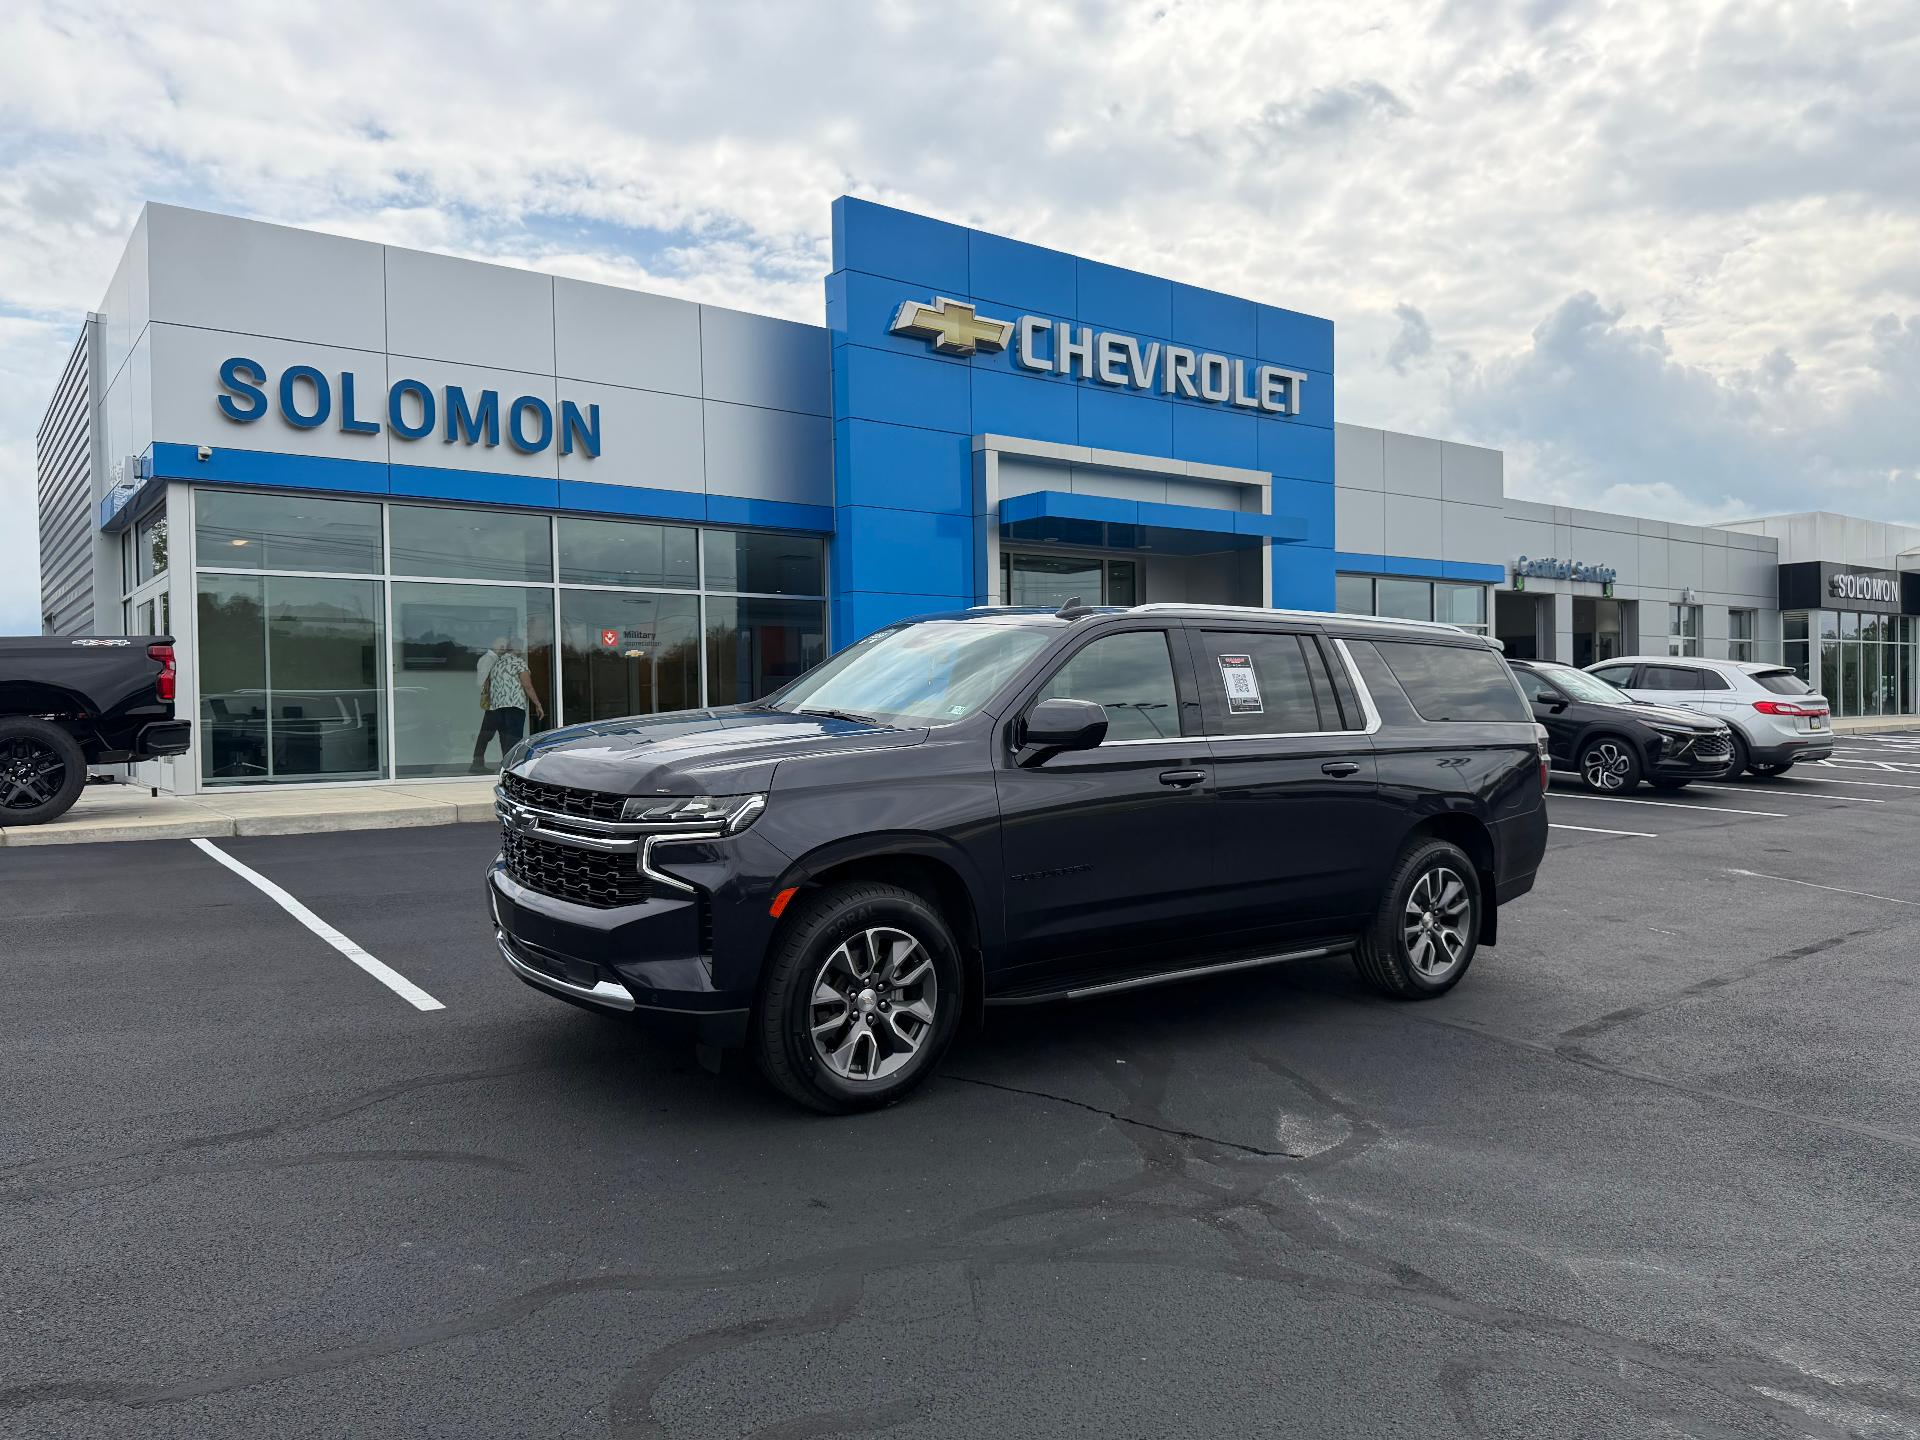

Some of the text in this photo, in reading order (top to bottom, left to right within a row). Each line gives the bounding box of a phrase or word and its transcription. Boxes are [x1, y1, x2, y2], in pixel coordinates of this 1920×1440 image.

[1015, 314, 1308, 416] CHEVROLET
[217, 357, 602, 459] SOLOMON
[1518, 555, 1617, 583] Certified Service
[1837, 574, 1898, 602] SOLOMON
[623, 631, 657, 640] Military
